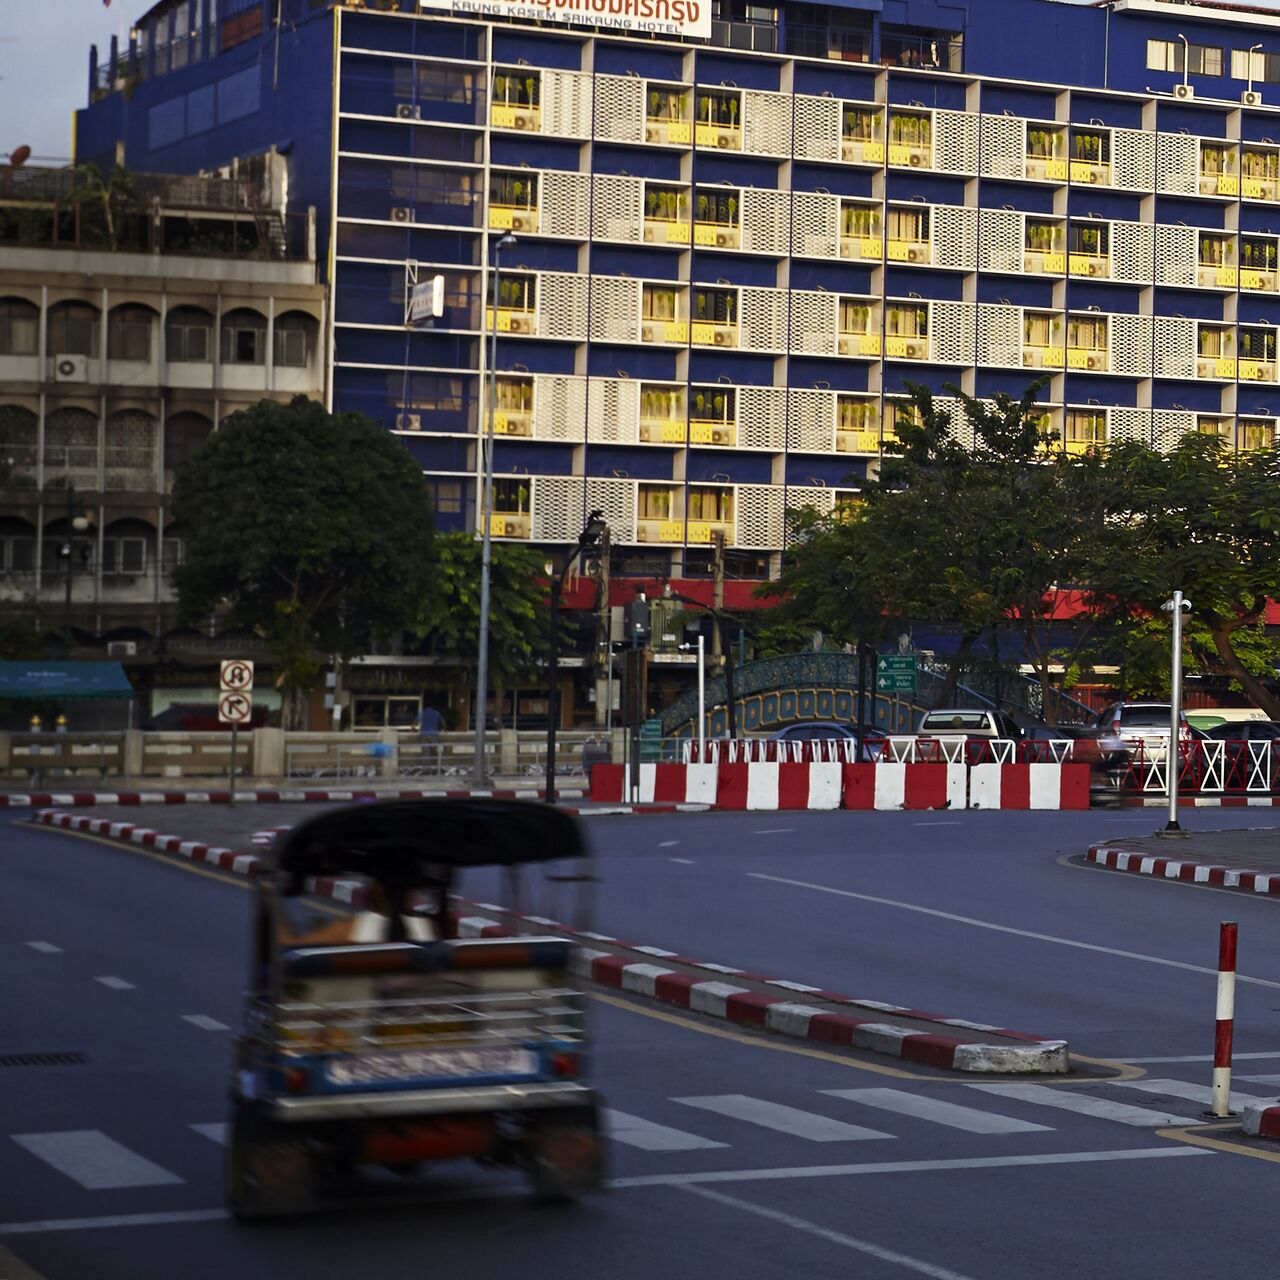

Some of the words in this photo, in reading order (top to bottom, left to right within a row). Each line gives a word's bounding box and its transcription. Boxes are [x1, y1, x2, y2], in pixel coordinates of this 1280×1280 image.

[452, 0, 501, 14] KRUNG
[507, 6, 556, 21] KASEM
[562, 13, 632, 29] SRIKRUNG
[637, 20, 683, 35] HOTEL
